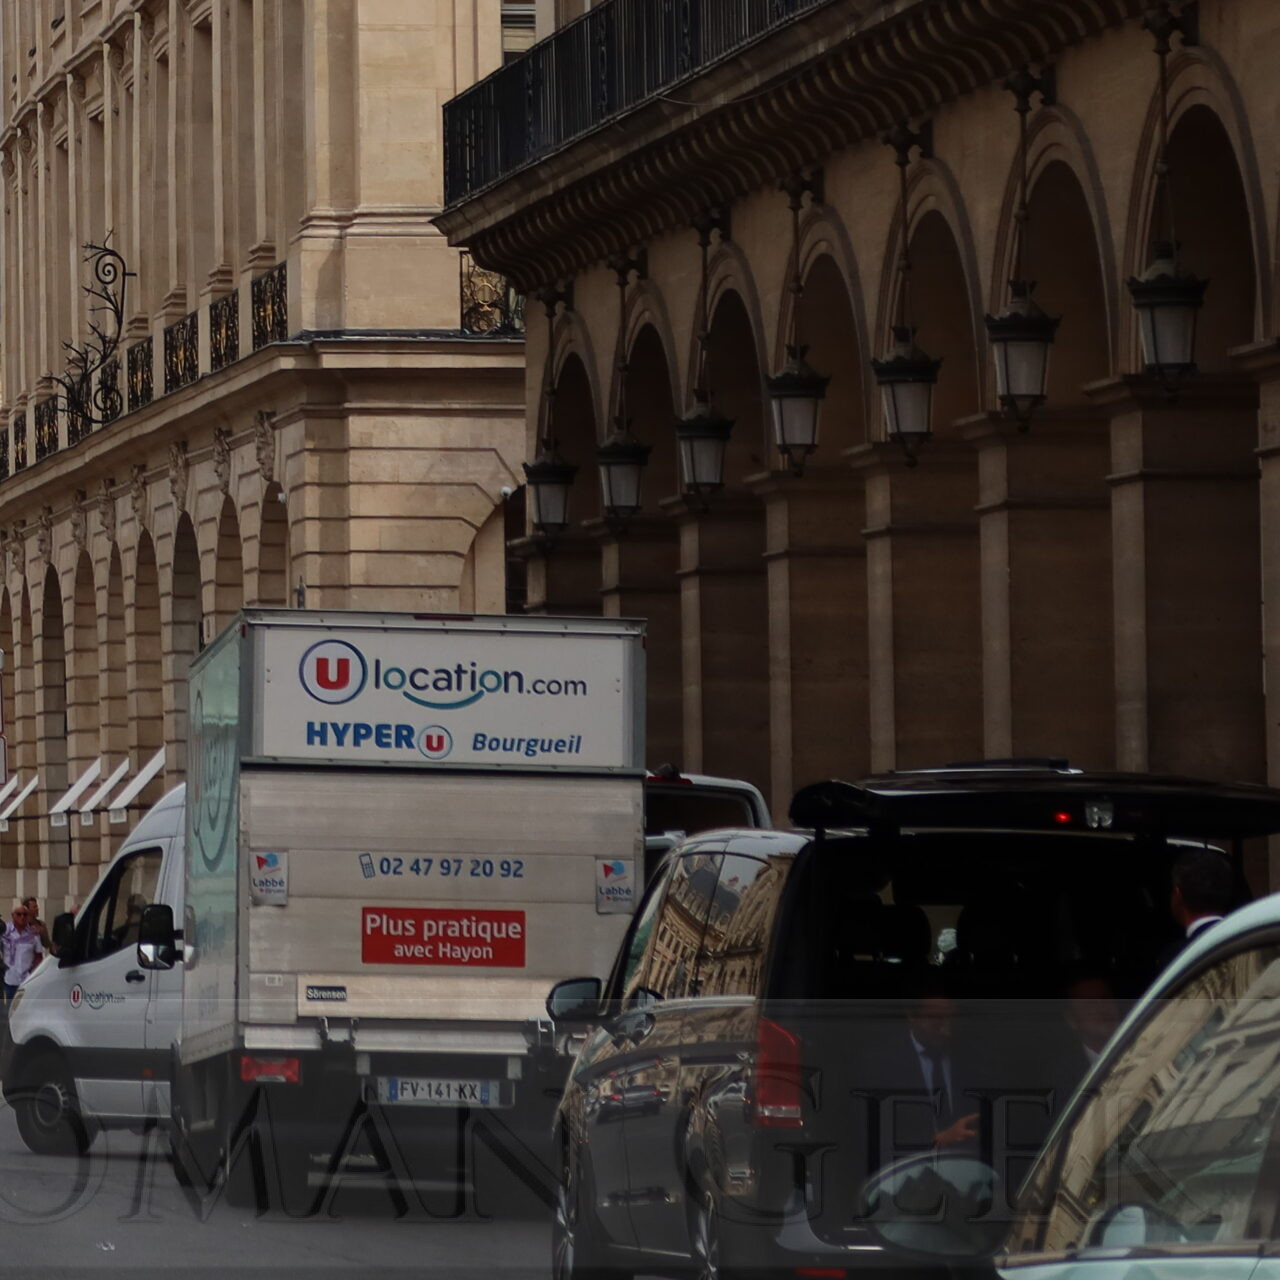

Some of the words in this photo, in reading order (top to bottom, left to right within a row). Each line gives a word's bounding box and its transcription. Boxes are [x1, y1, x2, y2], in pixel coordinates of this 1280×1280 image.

[306, 721, 416, 750] HYPER
[472, 732, 583, 755] Bourgueil
[379, 857, 403, 876] 02
[409, 857, 433, 876] 47
[440, 858, 464, 877] 97
[470, 859, 494, 878] 20
[500, 859, 525, 879] 92
[365, 914, 416, 938] Plus
[423, 915, 522, 942] pratique
[394, 944, 433, 959] avec
[439, 943, 494, 962] Hayon
